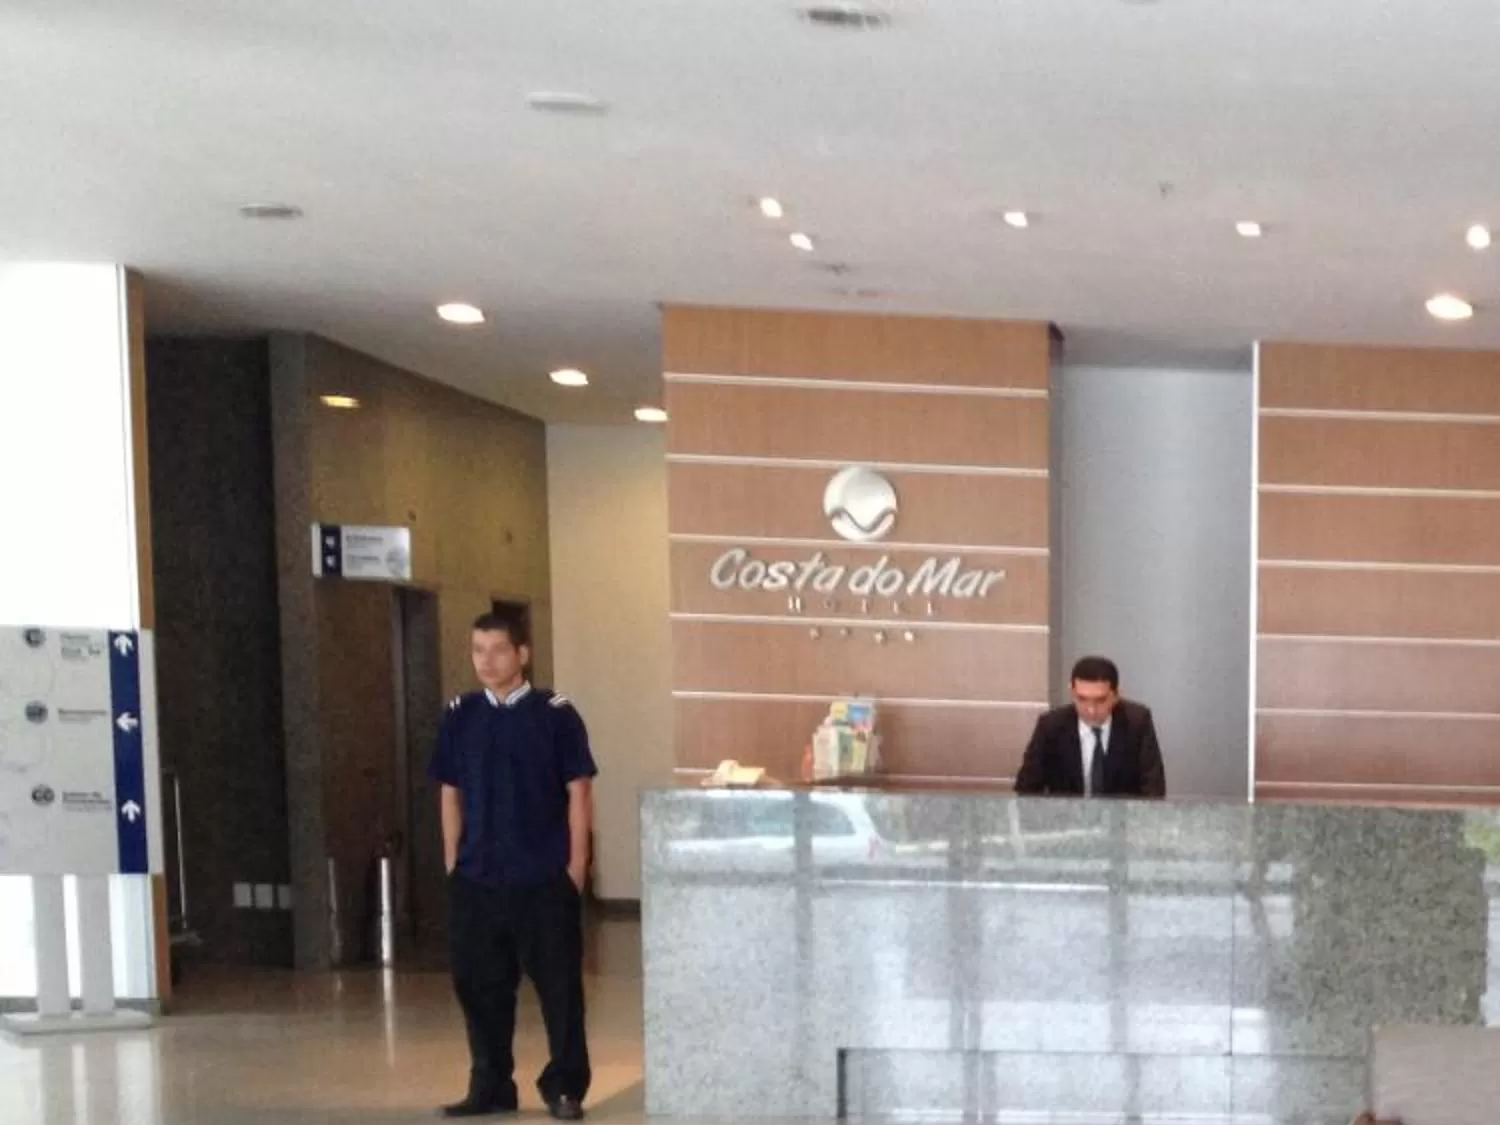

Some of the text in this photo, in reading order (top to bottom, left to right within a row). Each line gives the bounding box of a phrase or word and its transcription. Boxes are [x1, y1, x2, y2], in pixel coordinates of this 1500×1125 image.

[710, 549, 1004, 598] Costa do Mar
